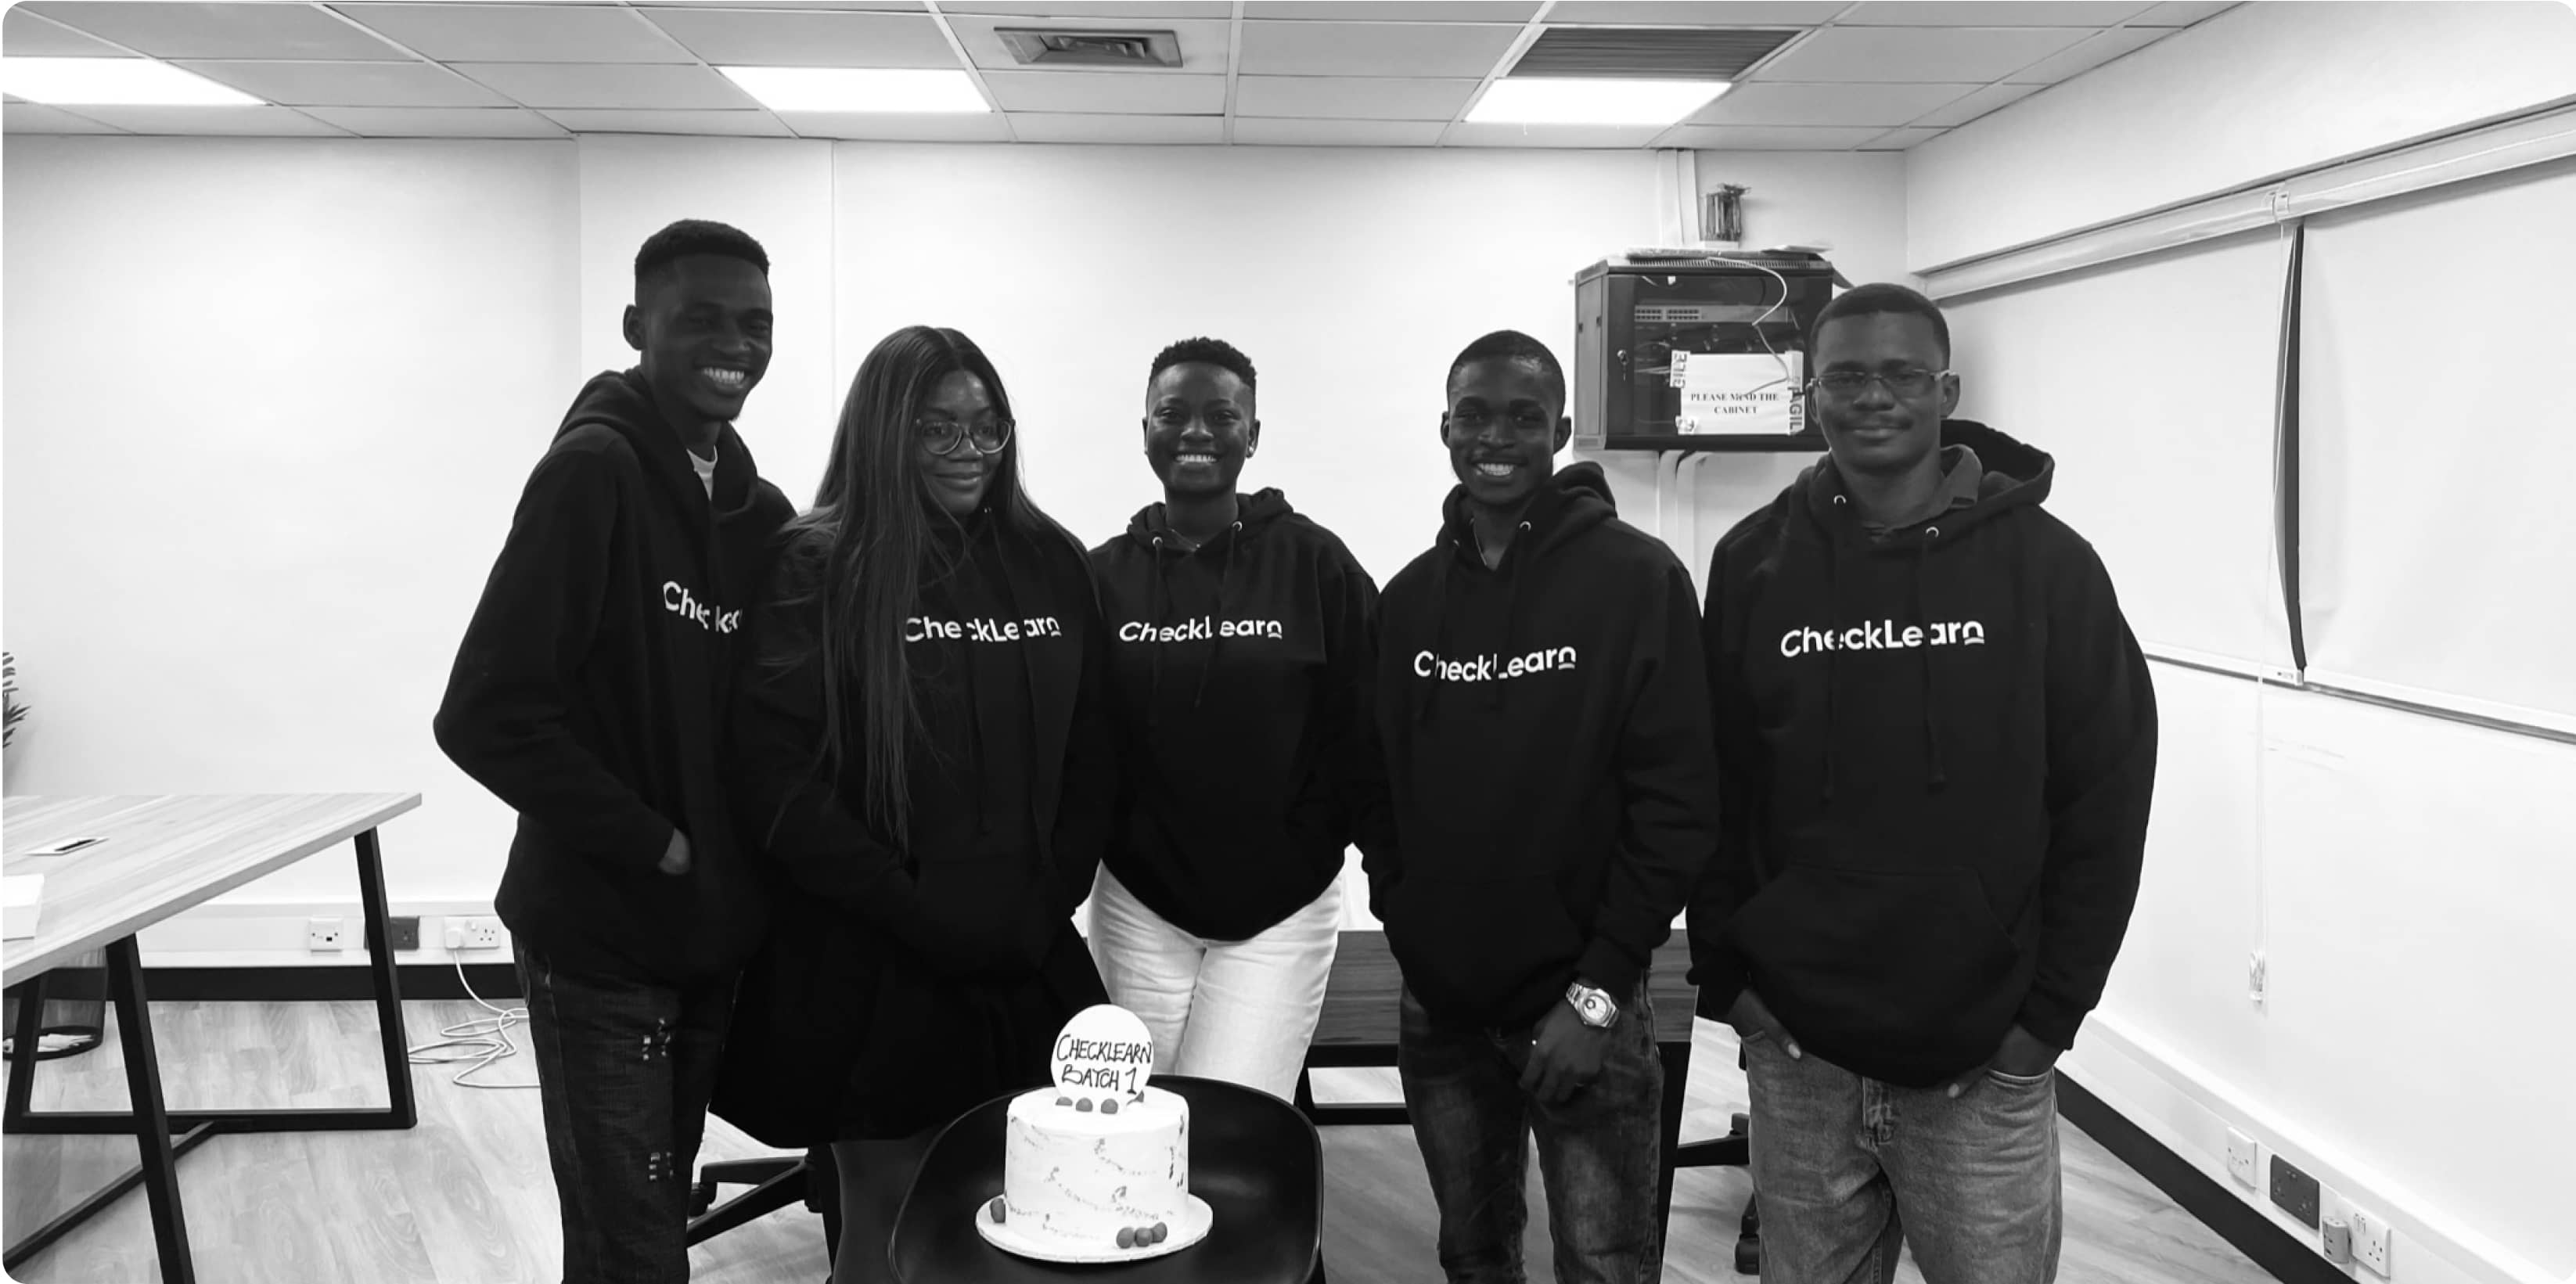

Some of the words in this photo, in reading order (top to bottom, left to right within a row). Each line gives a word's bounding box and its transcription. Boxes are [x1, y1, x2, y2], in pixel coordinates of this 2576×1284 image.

[1691, 393, 1727, 401] PLEASE
[1760, 393, 1779, 401] THE
[1120, 616, 1283, 642] CheckLearn
[1781, 619, 1984, 657] CheckLearn
[1057, 1034, 1152, 1064] CHECKLEARN
[1062, 1064, 1119, 1092] BATCH
[1125, 1066, 1137, 1095] 1
